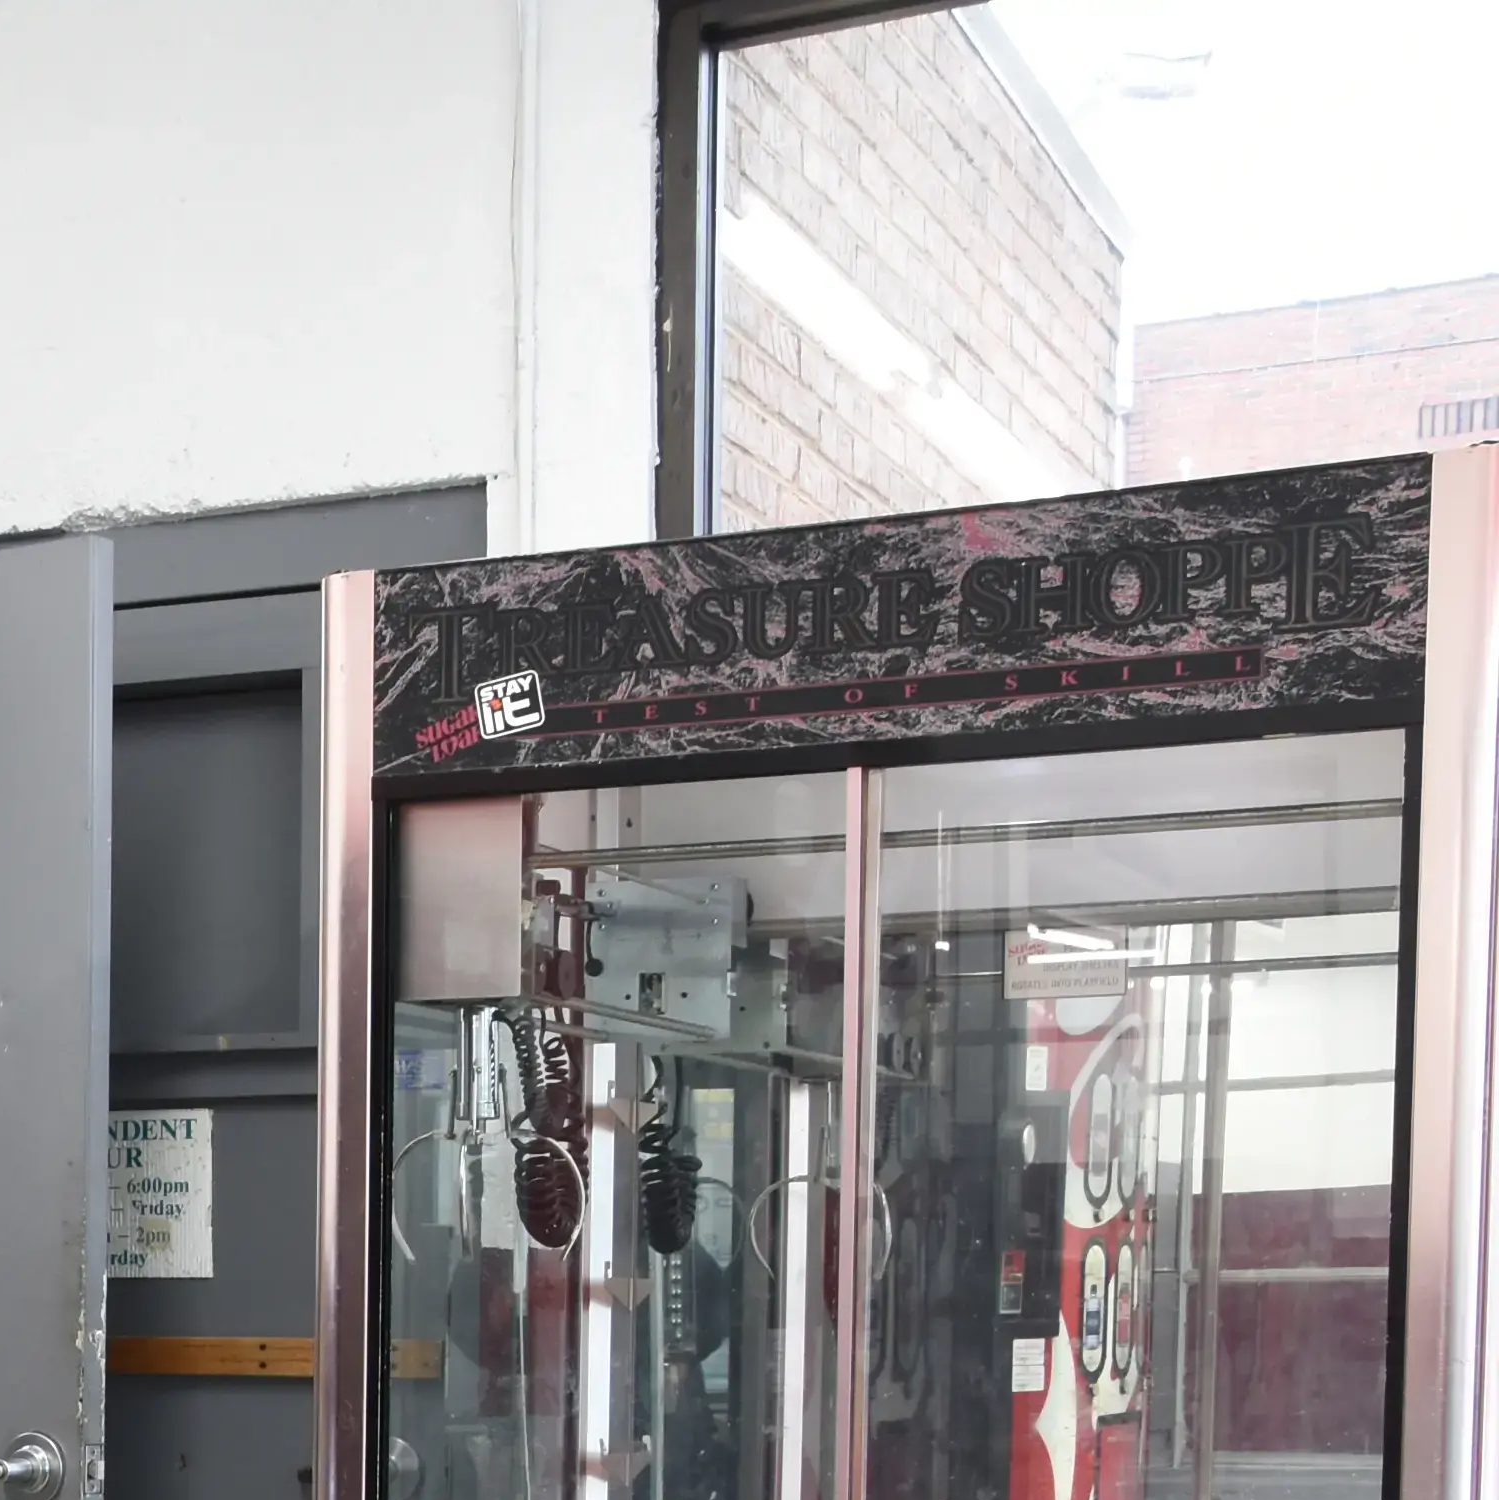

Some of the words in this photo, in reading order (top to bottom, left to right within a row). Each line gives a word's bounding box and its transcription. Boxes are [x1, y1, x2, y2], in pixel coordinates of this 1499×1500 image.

[960, 511, 1378, 639] SHOPPE
[406, 570, 939, 704] TREASURE
[480, 675, 532, 702] STAY
[592, 697, 761, 725] TEST
[844, 683, 918, 703] OF
[1005, 655, 1250, 691] SKILL
[127, 1178, 190, 1196] 6:00pm
[136, 1227, 171, 1245] 2pm
